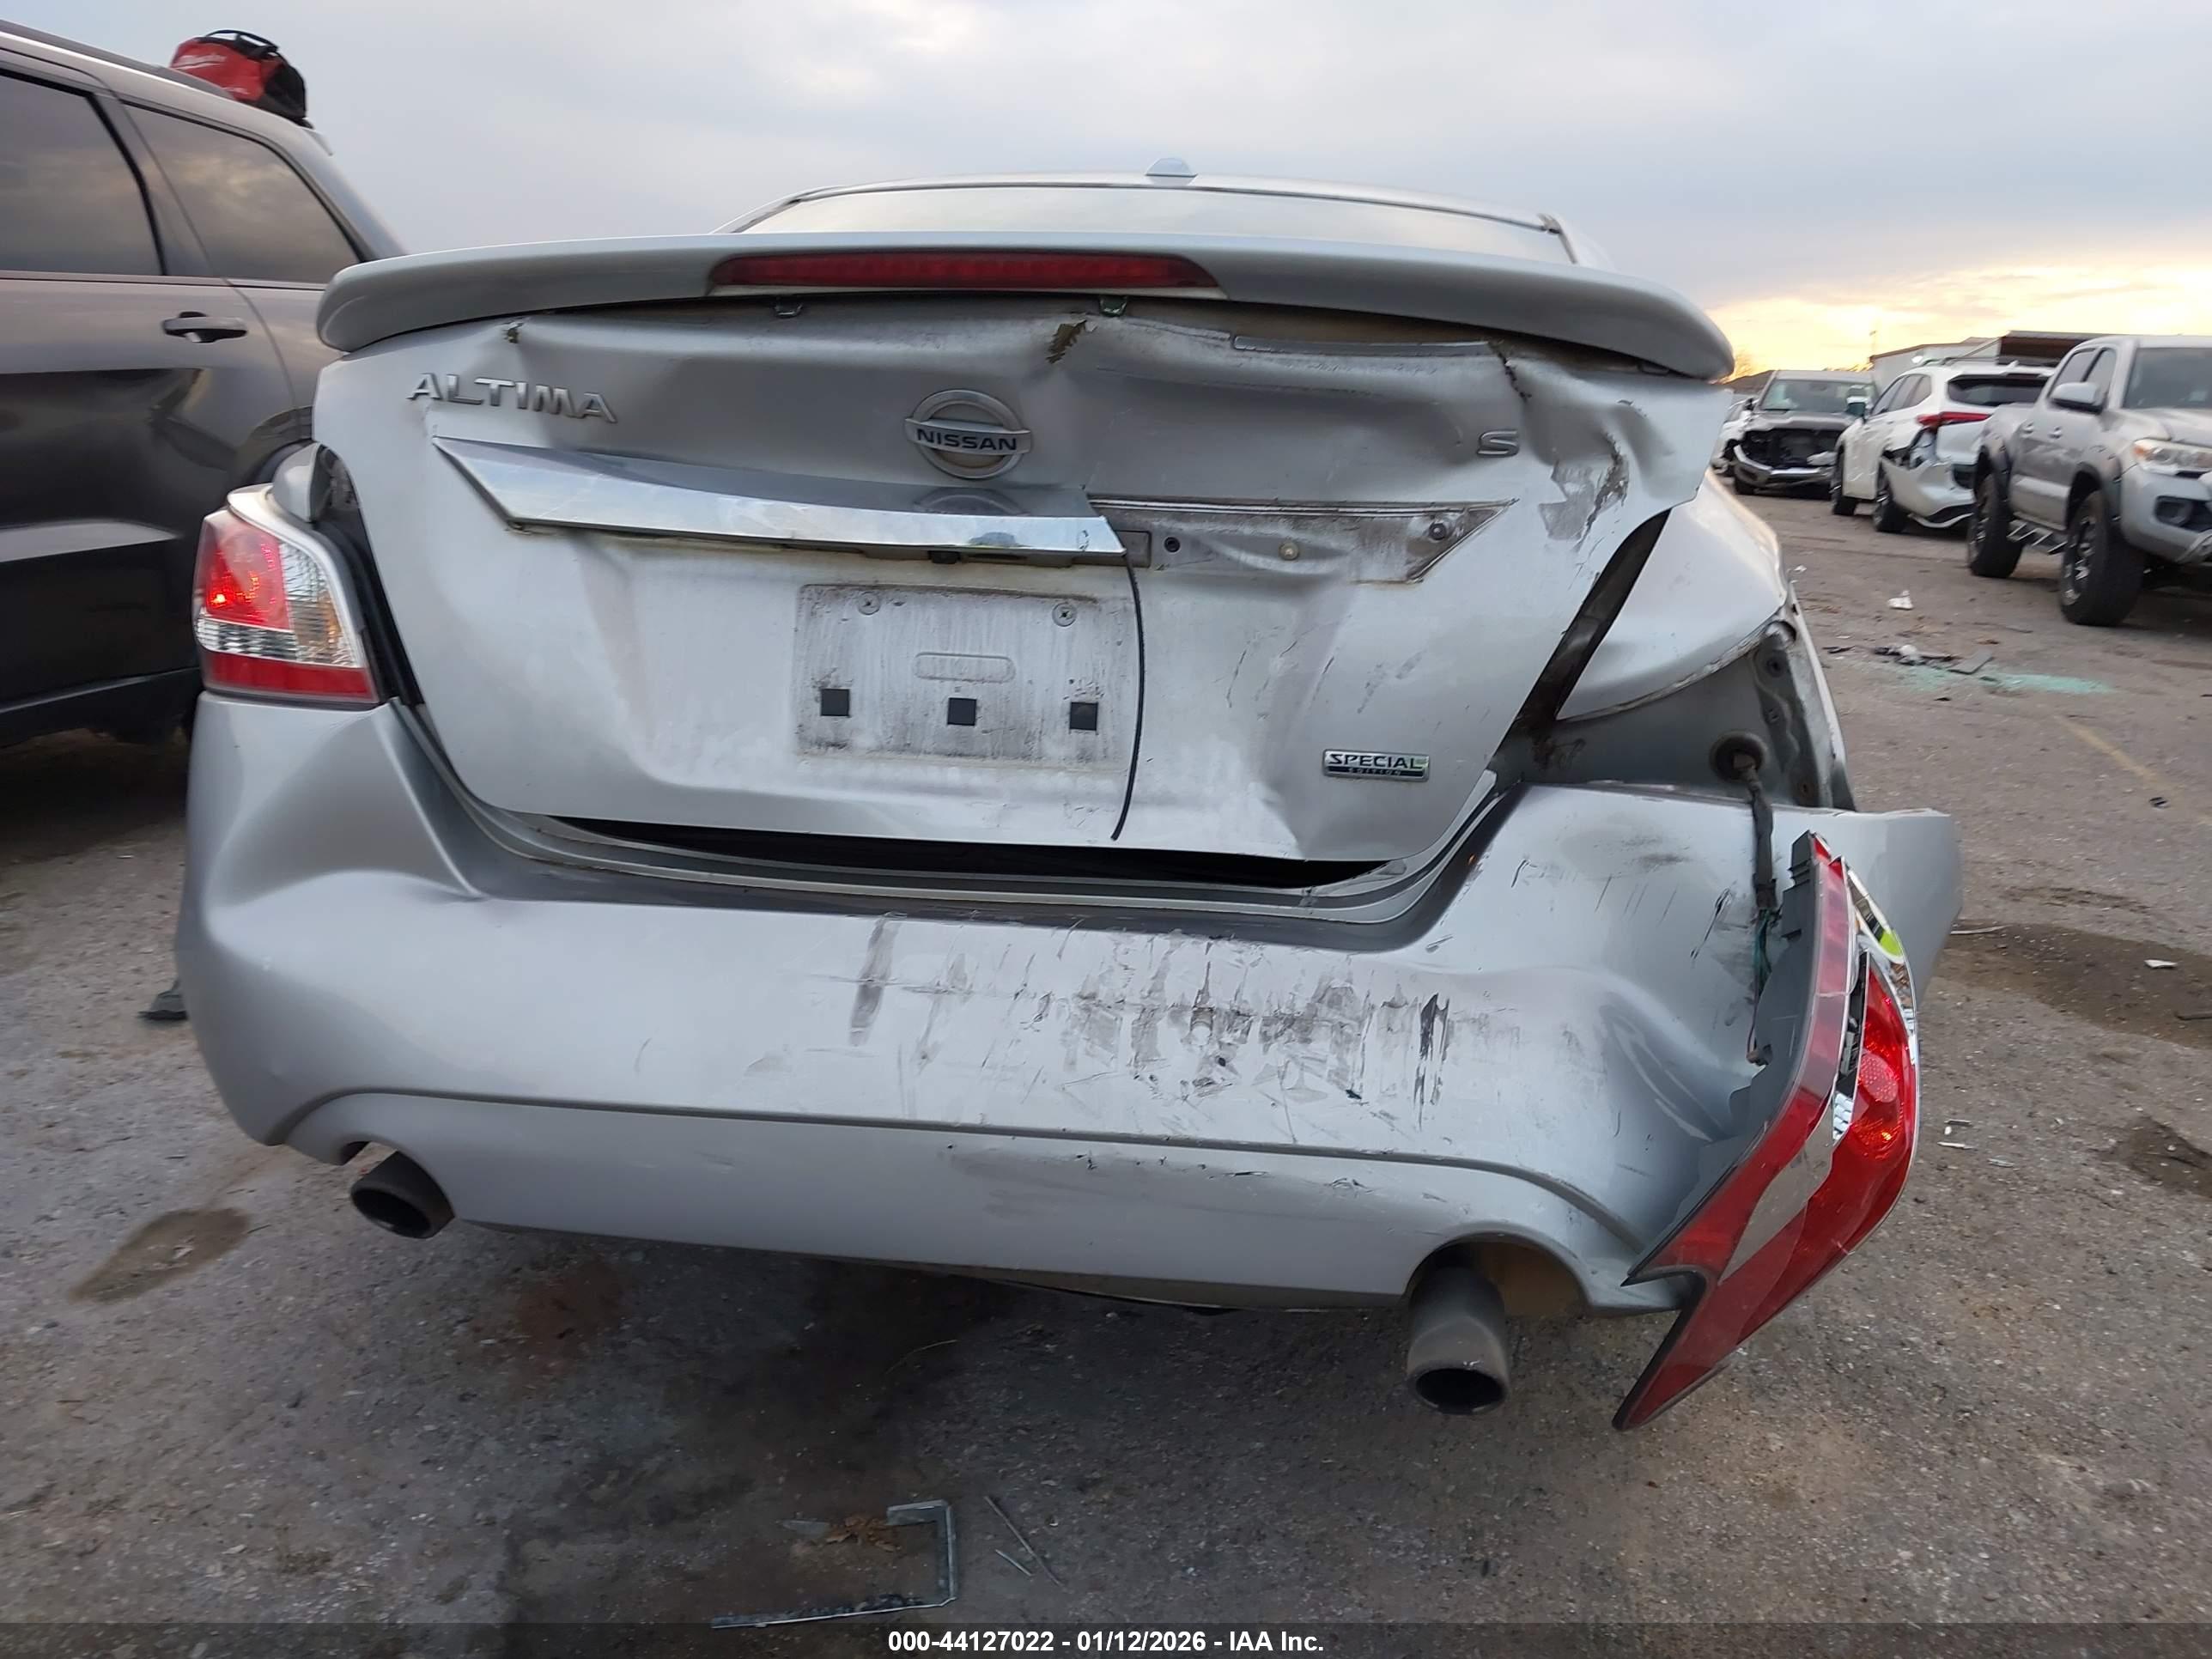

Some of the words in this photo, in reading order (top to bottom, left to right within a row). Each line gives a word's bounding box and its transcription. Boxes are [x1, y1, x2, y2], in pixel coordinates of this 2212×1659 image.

[406, 373, 618, 423] ALTIMA
[916, 428, 1017, 451] NISSAN
[1476, 429, 1519, 458] S
[1328, 753, 1423, 769] SPECIAL
